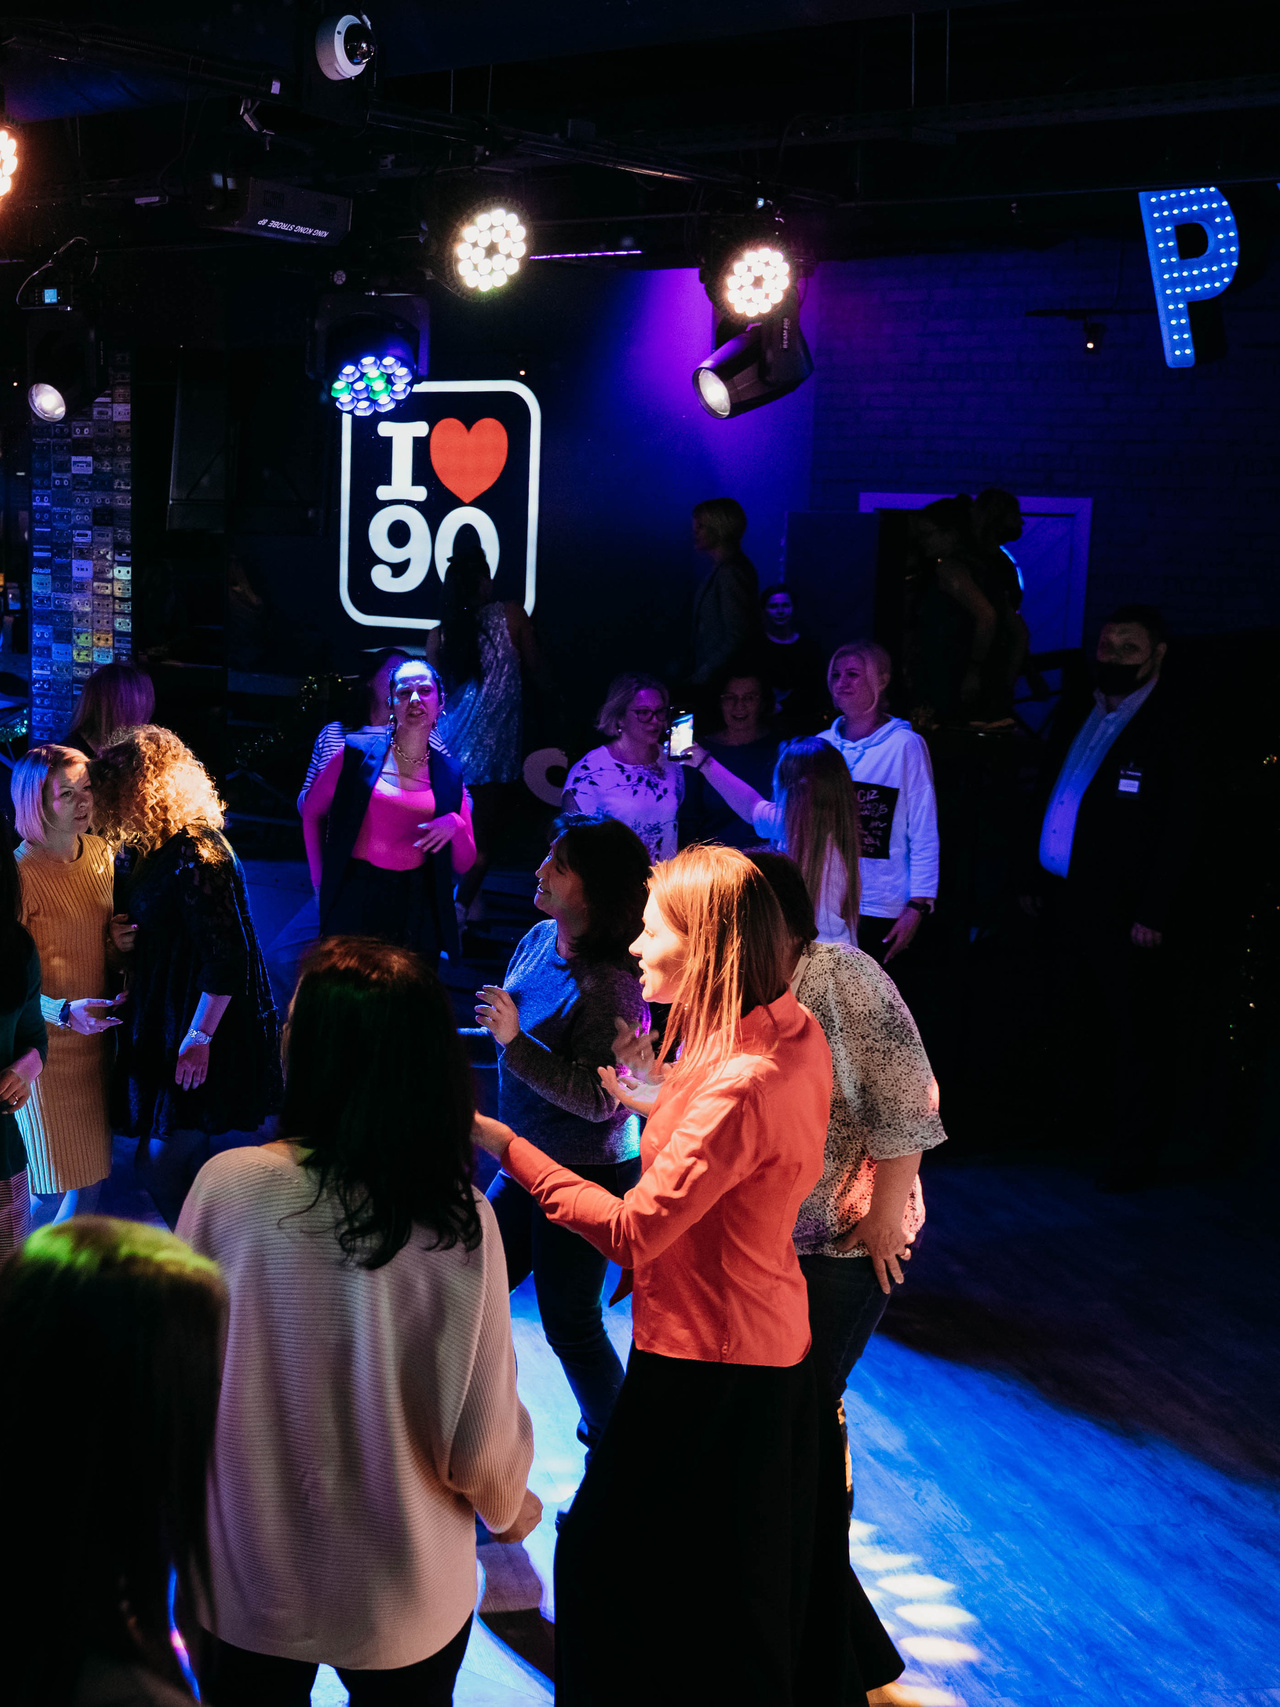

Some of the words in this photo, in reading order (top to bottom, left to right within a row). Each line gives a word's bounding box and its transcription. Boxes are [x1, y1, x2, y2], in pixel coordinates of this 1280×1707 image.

[268, 220, 295, 231] STROBE
[294, 225, 314, 235] KONG
[312, 229, 329, 237] KING
[376, 421, 429, 501] I
[368, 504, 500, 593] 90
